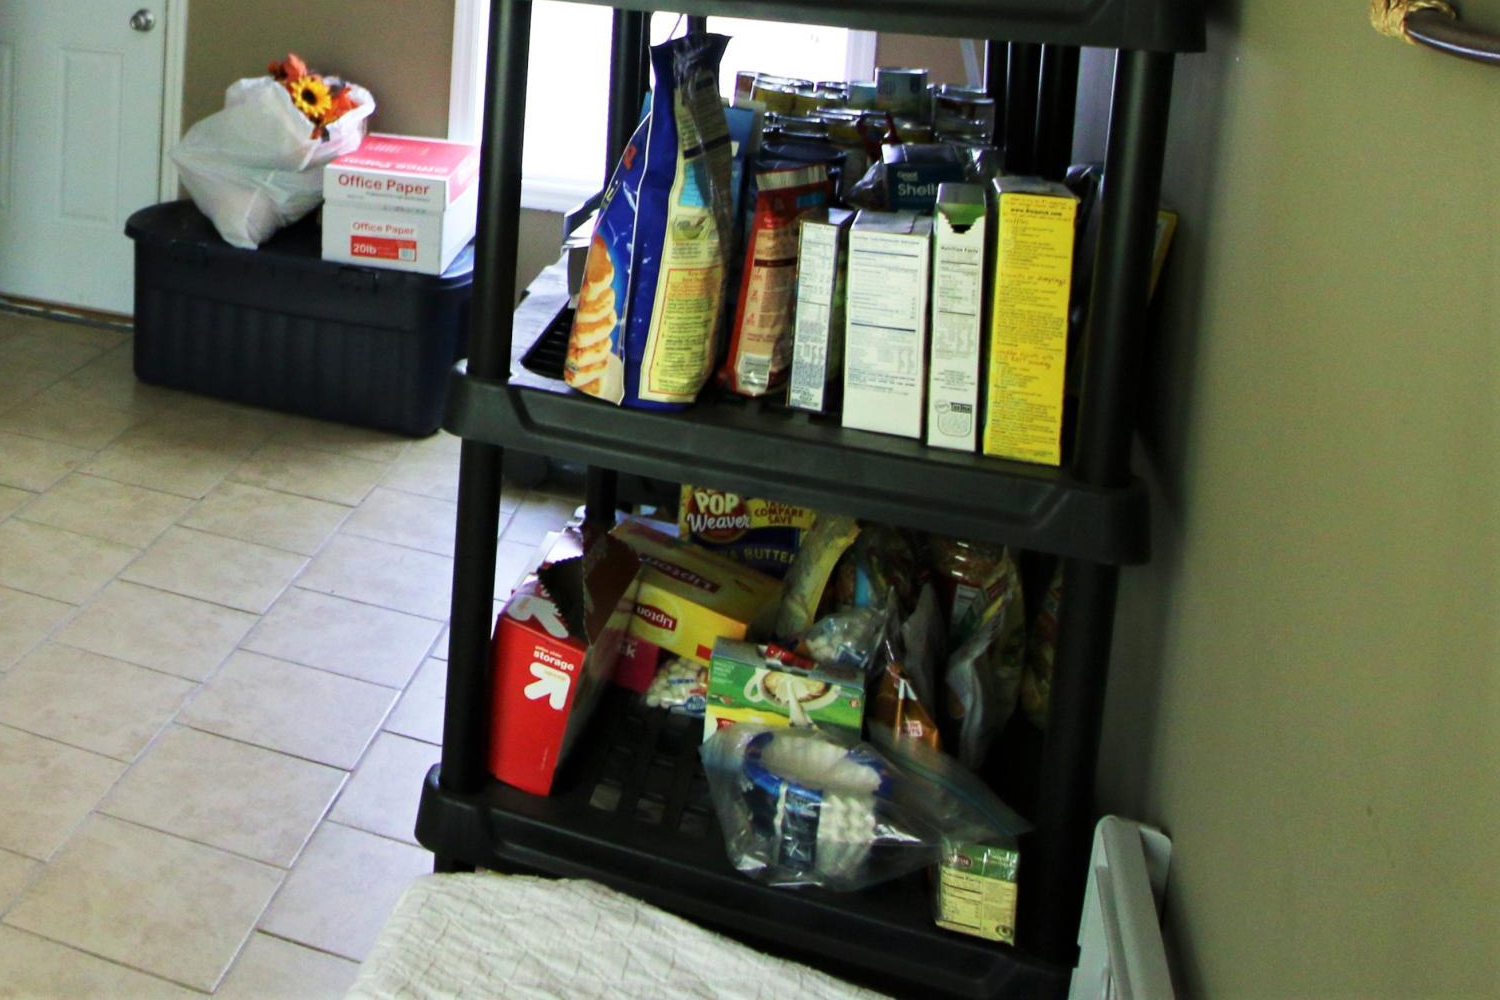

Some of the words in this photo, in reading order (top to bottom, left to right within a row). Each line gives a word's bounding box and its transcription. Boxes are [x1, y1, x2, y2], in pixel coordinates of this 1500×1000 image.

[338, 173, 383, 191] Office
[386, 178, 431, 196] Paper
[352, 220, 383, 234] Office
[384, 223, 415, 236] Paper
[352, 242, 377, 255] 20lb
[694, 491, 740, 516] POP
[687, 513, 750, 533] Weaver
[636, 605, 674, 630] Lipton
[533, 649, 574, 671] storage
